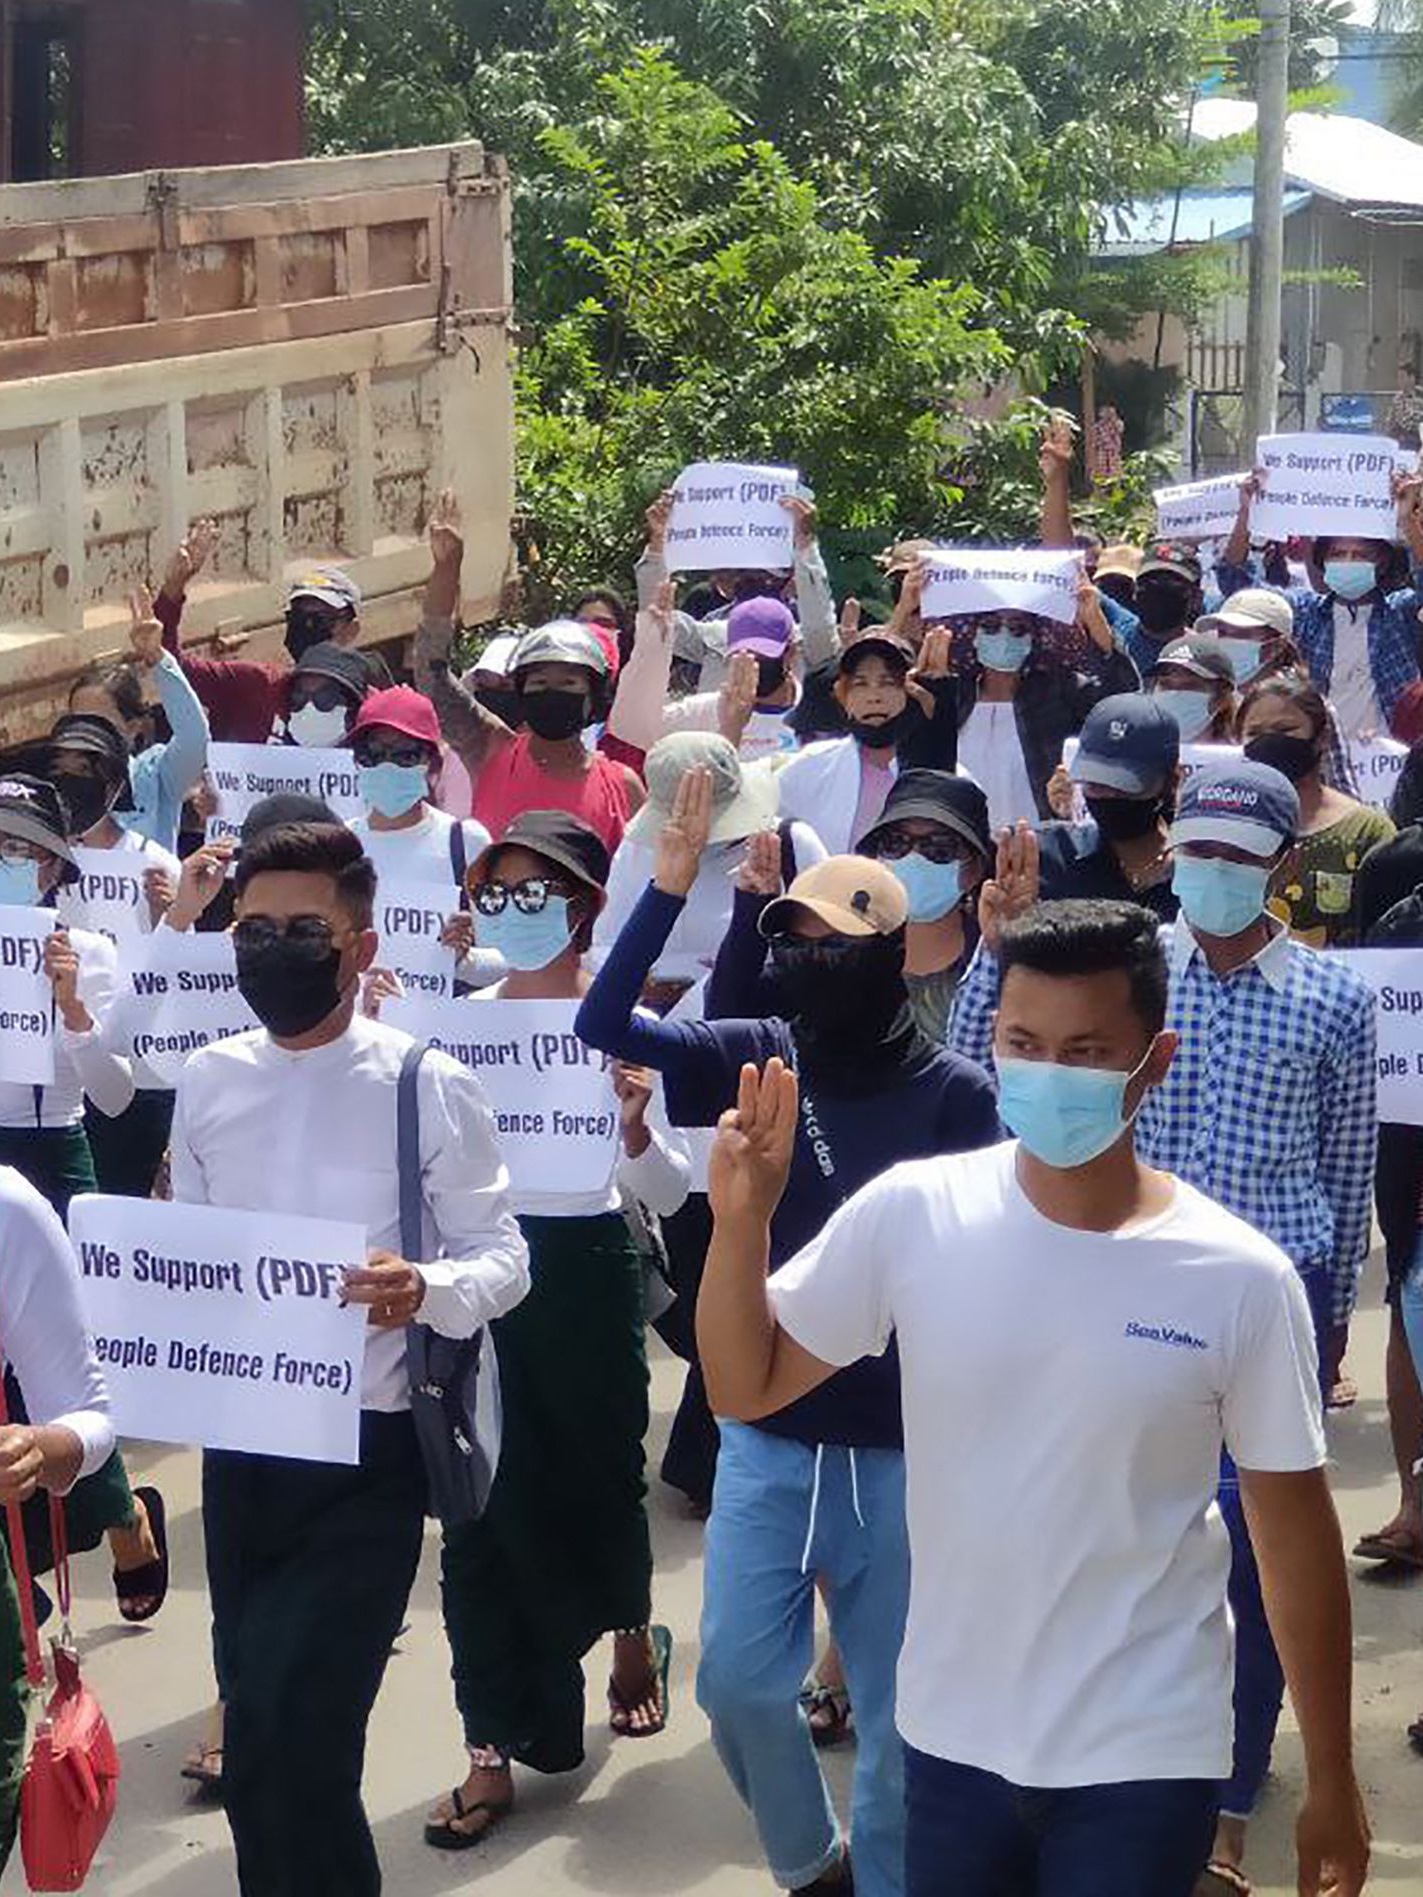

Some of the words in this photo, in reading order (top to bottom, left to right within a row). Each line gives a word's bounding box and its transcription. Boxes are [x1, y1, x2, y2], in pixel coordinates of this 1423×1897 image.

[1287, 453, 1342, 472] Support
[1347, 452, 1395, 475] (PDF)
[215, 772, 240, 791] We
[79, 871, 140, 904] (PDF)
[132, 971, 168, 995] We
[178, 970, 237, 993] Supp
[133, 1030, 210, 1058] (People
[553, 1110, 616, 1140] Force)
[80, 1241, 121, 1279] We
[133, 1248, 244, 1294] Support
[93, 1336, 158, 1369] eople
[167, 1340, 263, 1380] Defence
[272, 1352, 352, 1396] Force)
